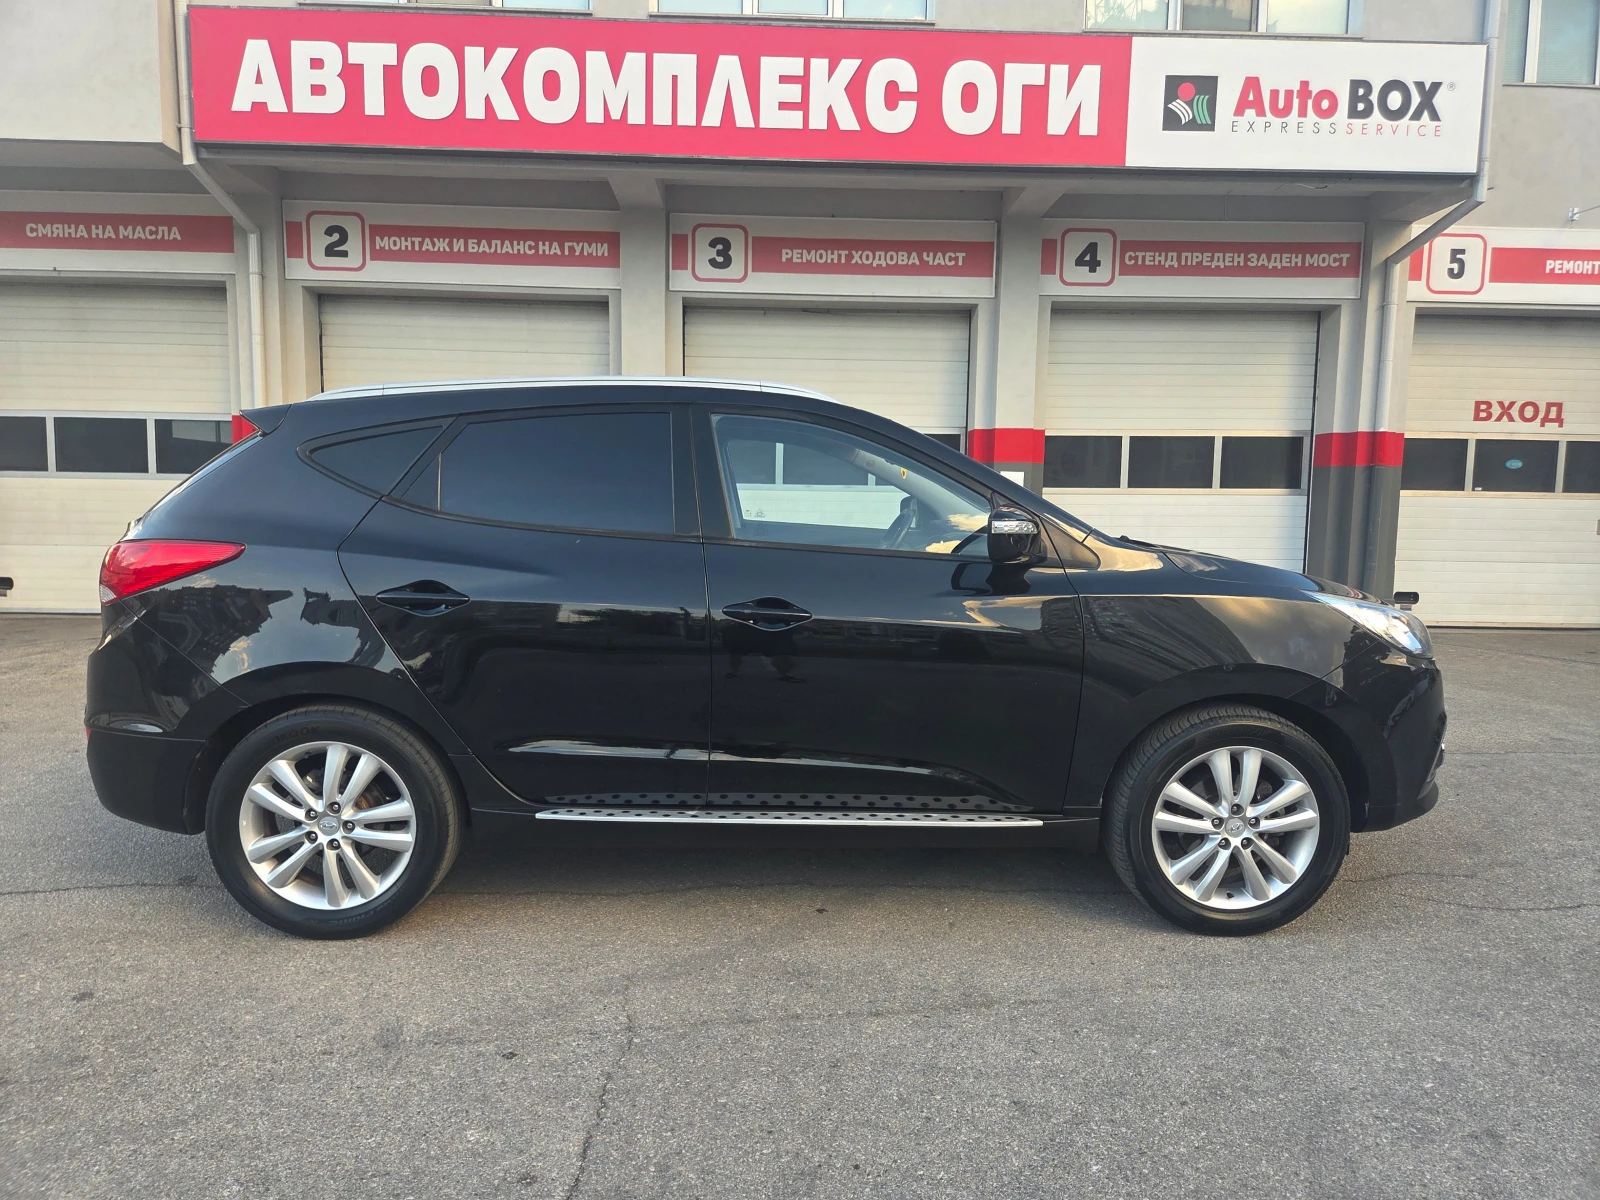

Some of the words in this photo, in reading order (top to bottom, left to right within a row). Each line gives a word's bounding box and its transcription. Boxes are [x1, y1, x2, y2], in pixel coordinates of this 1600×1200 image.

[230, 38, 918, 134] АВТОКОМПЛЕКС
[941, 59, 1102, 136] ОГИ
[1232, 76, 1339, 120] Auto
[25, 222, 89, 239] СМЯНА
[91, 224, 117, 239] НА
[118, 225, 182, 241] МАСЛА
[323, 224, 349, 258] 2
[375, 235, 451, 252] МОНТАЖ
[452, 238, 465, 253] И
[467, 238, 536, 255] БАЛАНС
[538, 241, 562, 256] НА
[564, 241, 609, 257] ГУМИ
[707, 236, 733, 270] 3
[781, 248, 849, 264] РЕМОНТ
[850, 250, 920, 268] ХОДОВА
[922, 251, 966, 266] ЧАСТ
[1074, 241, 1102, 274] 4
[1124, 251, 1179, 269] СТЕНД
[1180, 252, 1245, 269] ПРЕДЕН
[1246, 252, 1302, 270] ЗАДЕН
[1304, 253, 1351, 268] МОСТ
[1447, 248, 1467, 280] 5
[1545, 259, 1600, 275] РЕМОНТ
[1472, 400, 1565, 429] ВХОД
